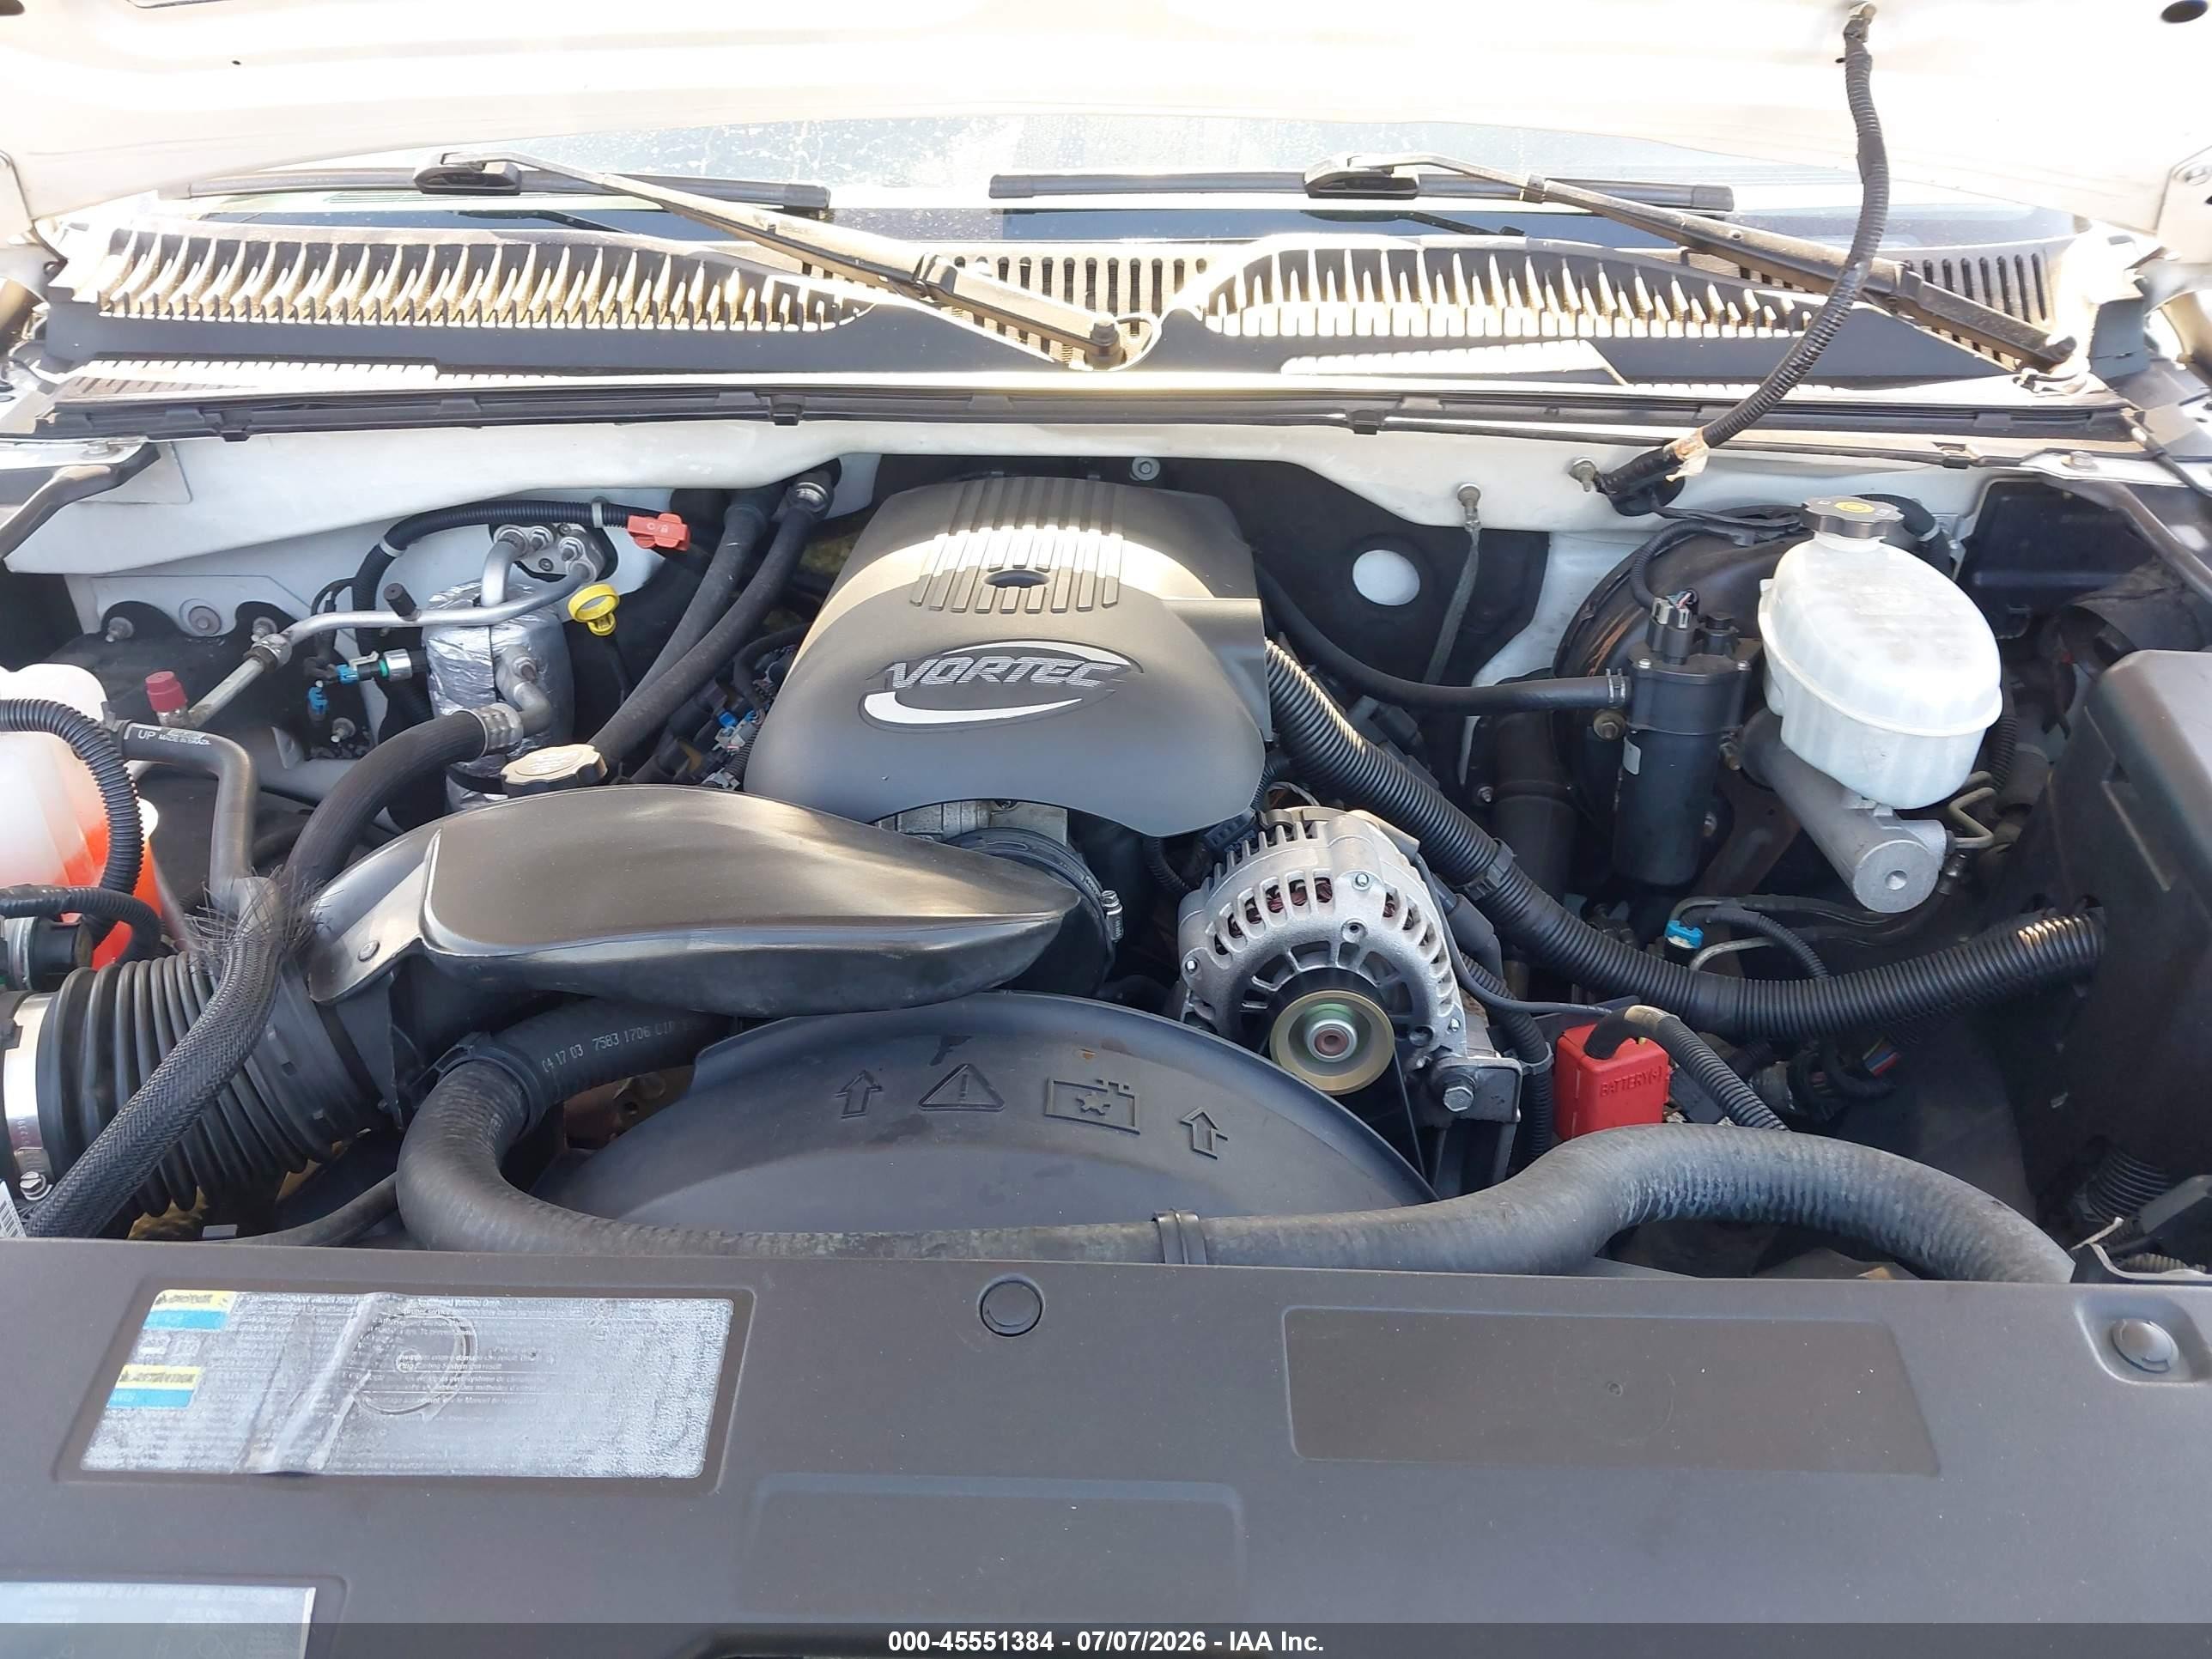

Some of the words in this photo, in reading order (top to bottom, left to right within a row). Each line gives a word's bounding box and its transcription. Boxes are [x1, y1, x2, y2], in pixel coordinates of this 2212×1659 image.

[885, 656, 1121, 690] VORTEC
[137, 730, 156, 740] UP
[555, 1050, 567, 1066] 17
[569, 1043, 584, 1059] 03
[592, 1032, 620, 1052] 7583
